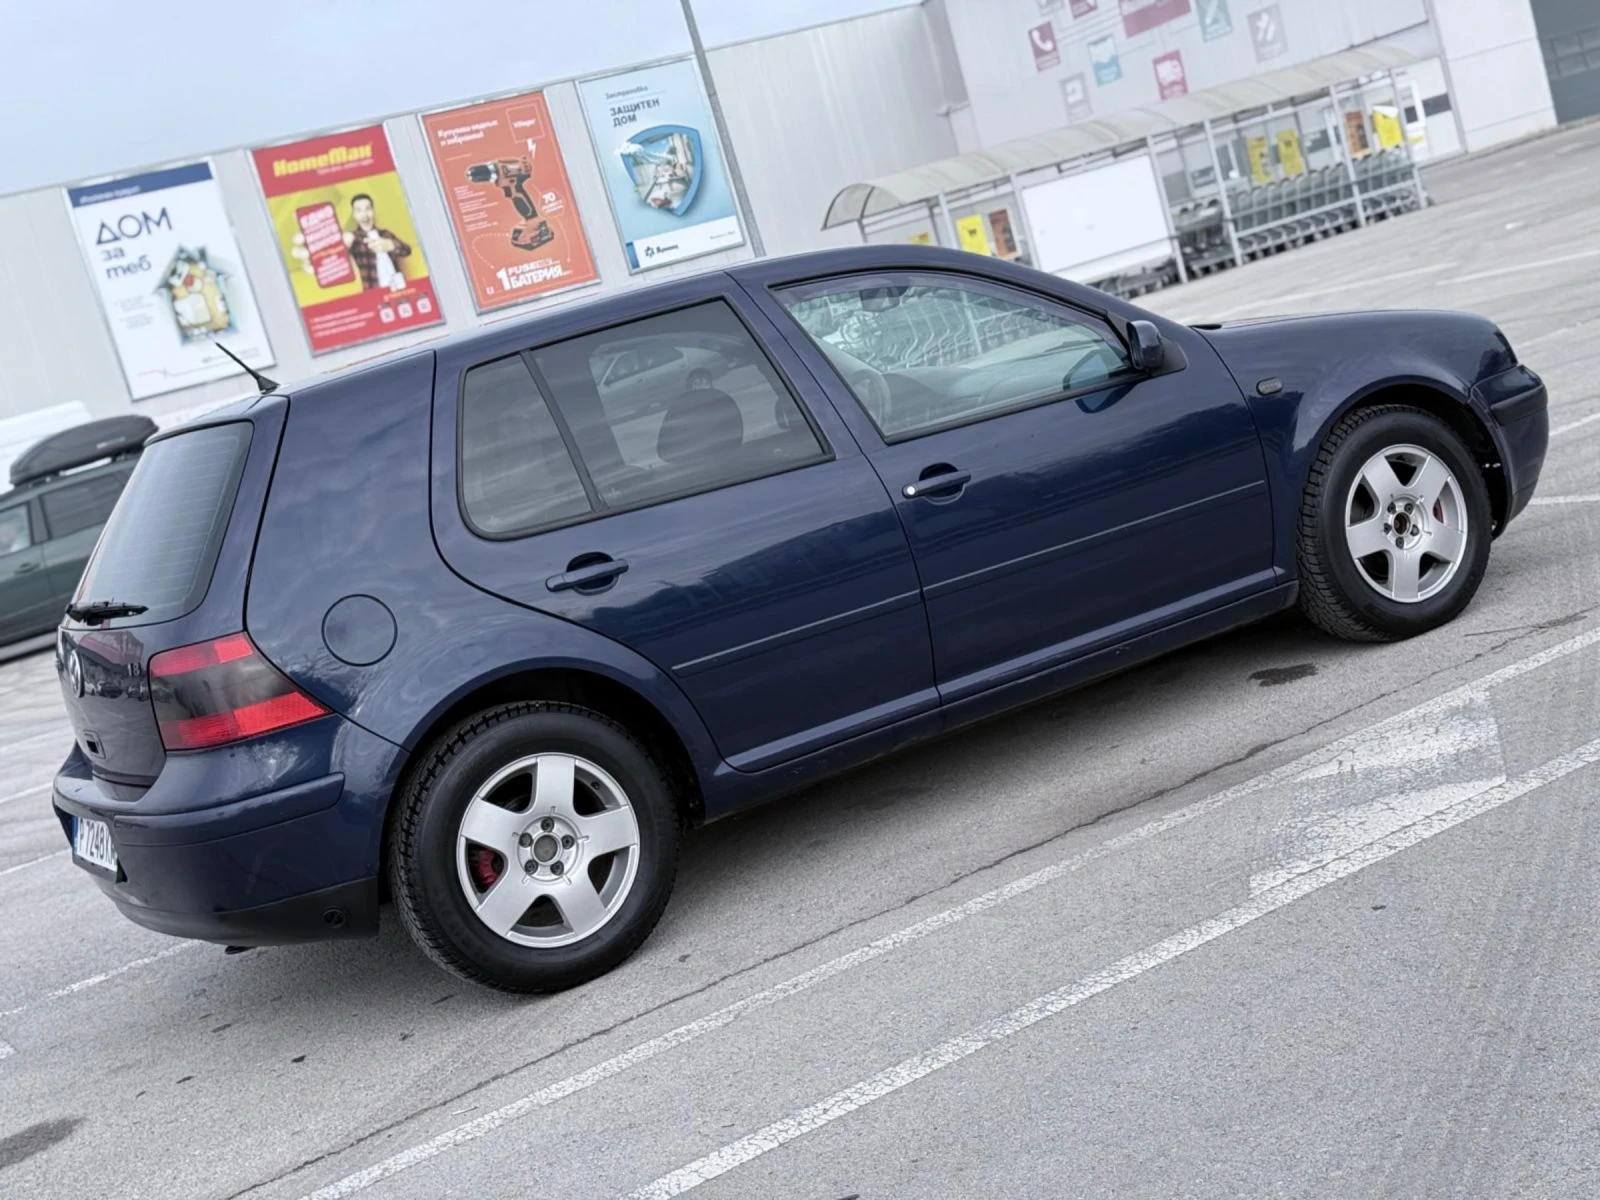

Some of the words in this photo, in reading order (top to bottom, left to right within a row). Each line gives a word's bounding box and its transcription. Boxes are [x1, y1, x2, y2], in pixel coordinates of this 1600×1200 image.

[609, 98, 660, 118] ЗАЩИТЕН
[613, 113, 638, 128] ДОМ
[96, 206, 173, 245] ДОМ
[102, 246, 126, 262] за
[106, 254, 152, 280] теб
